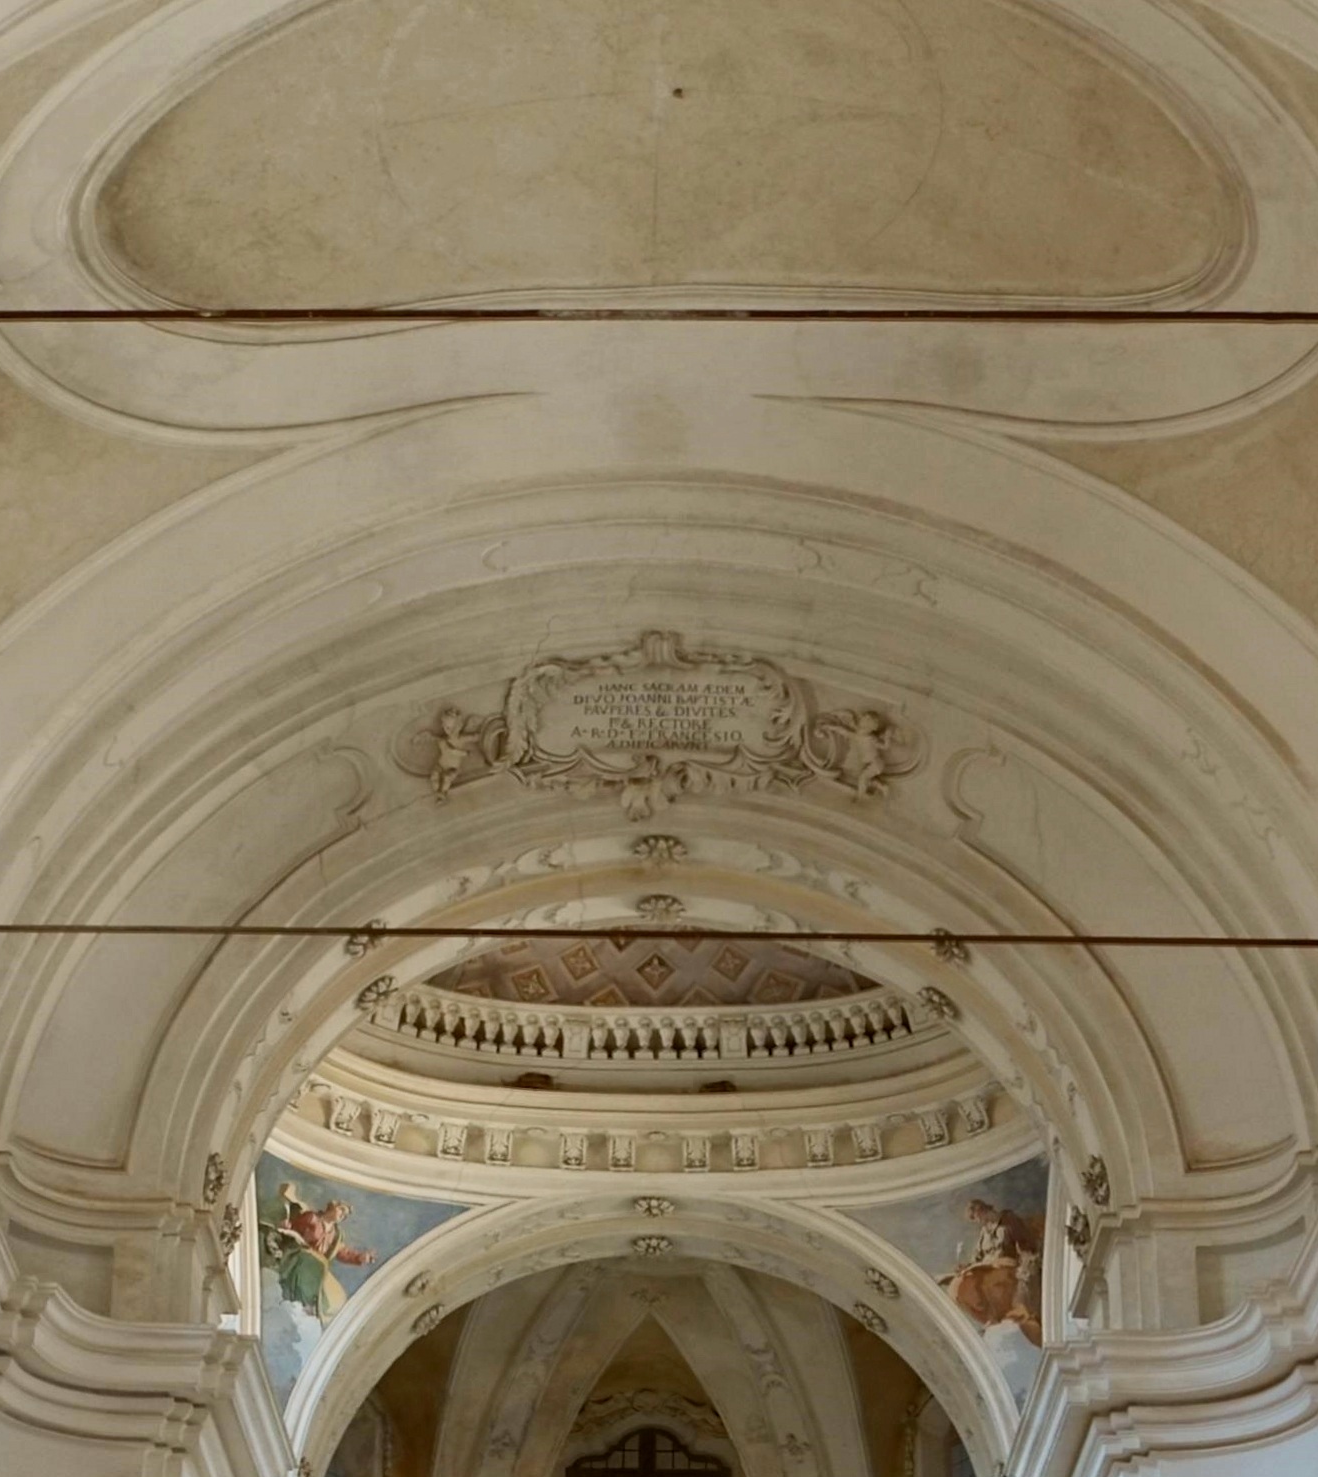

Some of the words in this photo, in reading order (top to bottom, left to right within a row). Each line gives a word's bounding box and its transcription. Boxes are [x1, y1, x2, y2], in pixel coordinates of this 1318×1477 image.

[598, 683, 636, 693] HANC
[642, 683, 698, 694] SACRAM
[574, 694, 615, 705] DIVO
[674, 706, 737, 718] DIVITES
[637, 718, 711, 731] RECTORE
